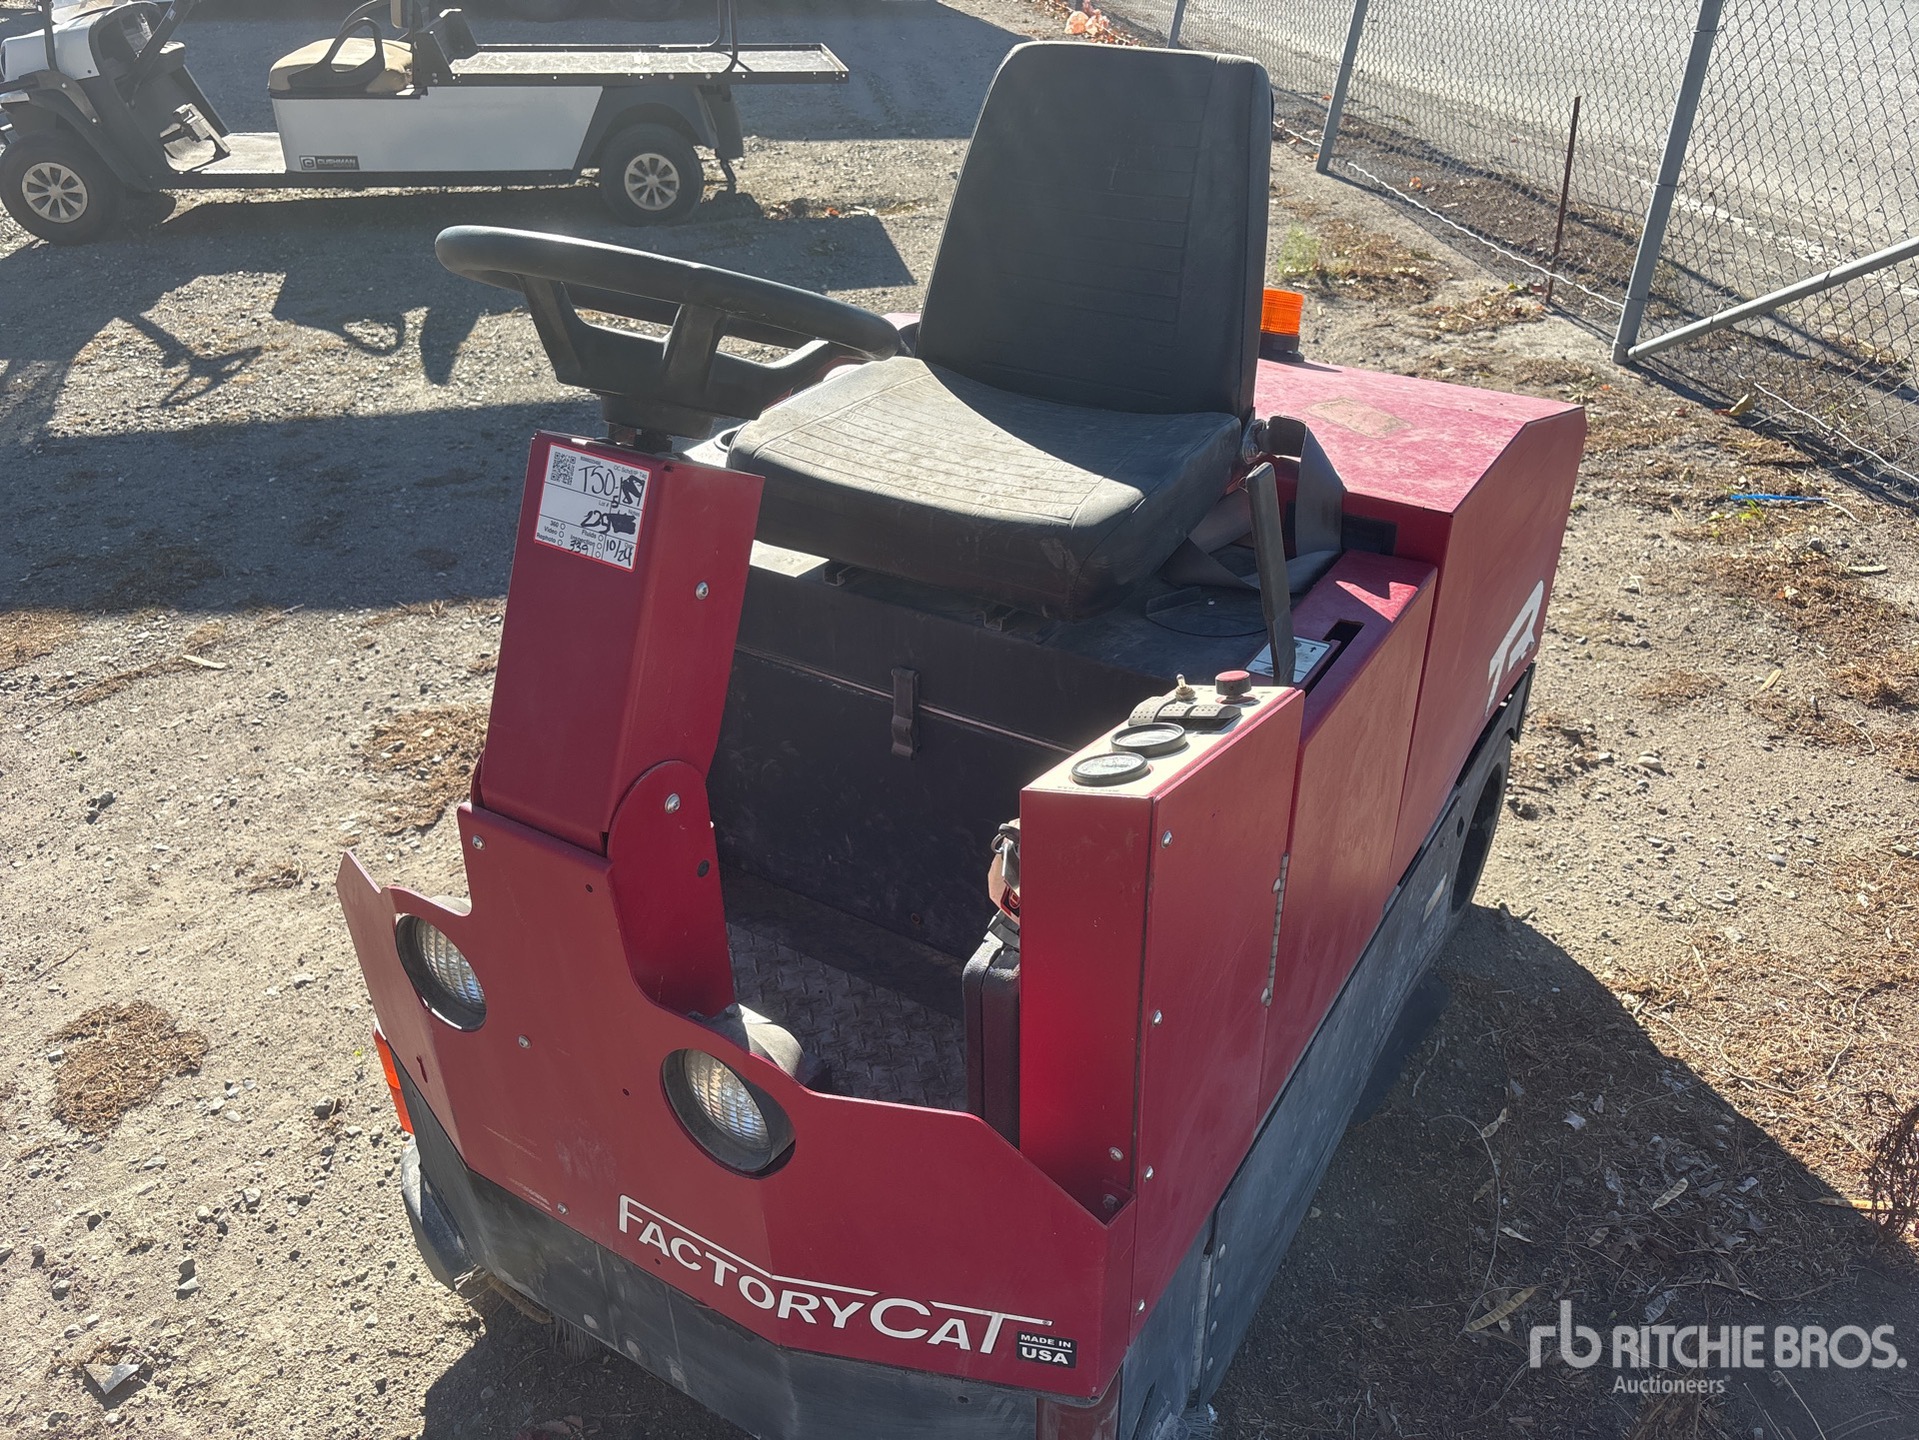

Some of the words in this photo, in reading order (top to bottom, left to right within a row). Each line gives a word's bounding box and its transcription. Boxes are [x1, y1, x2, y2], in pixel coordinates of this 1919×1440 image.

[544, 525, 557, 535] Video
[1020, 1333, 1056, 1347] MADE
[1058, 1337, 1072, 1349] IN
[1020, 1346, 1070, 1366] USA
